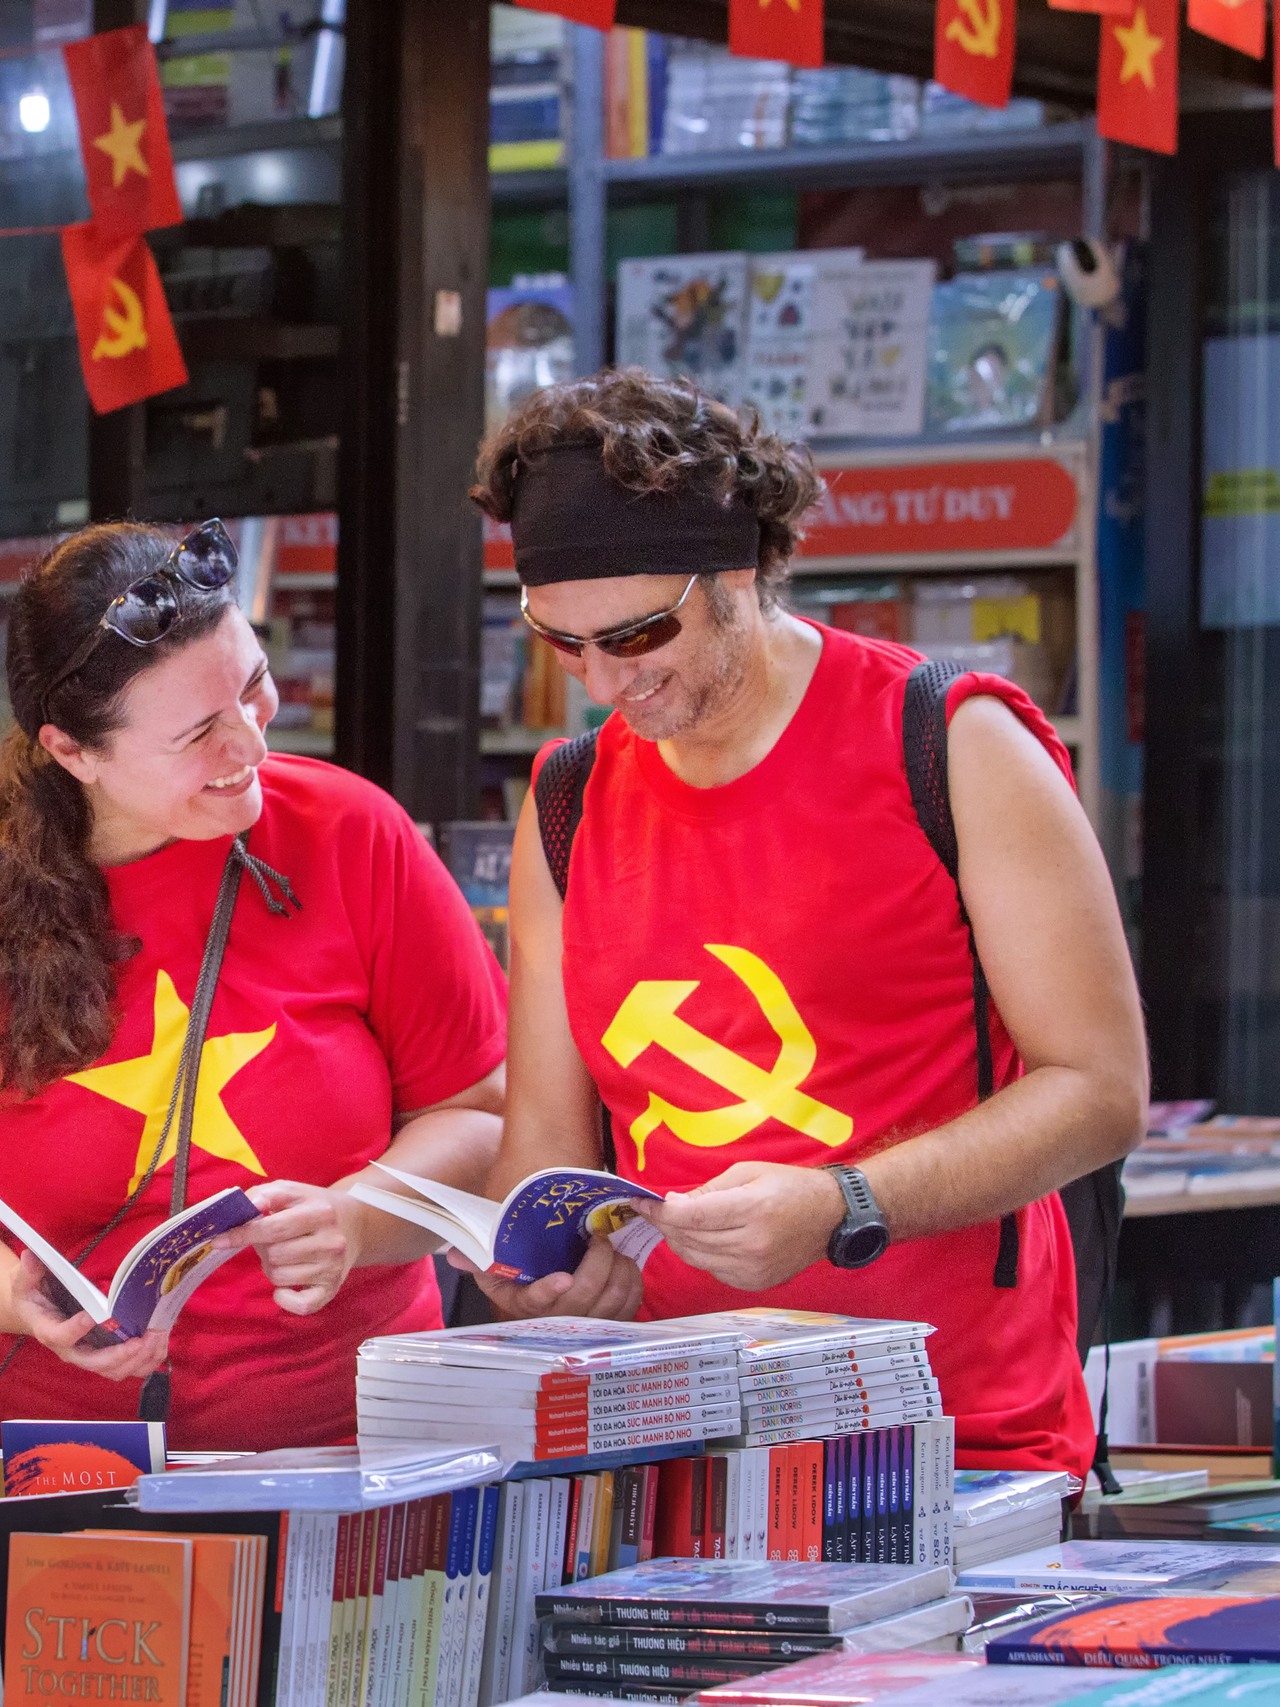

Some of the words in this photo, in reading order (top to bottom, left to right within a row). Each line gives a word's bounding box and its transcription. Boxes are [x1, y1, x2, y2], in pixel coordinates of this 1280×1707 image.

[943, 486, 1016, 522] DUY
[750, 1363, 768, 1373] DANA
[769, 1360, 790, 1369] NORRIS
[754, 1377, 771, 1386] DANA
[772, 1374, 793, 1383] NORRIS
[758, 1391, 775, 1401] DANA
[776, 1388, 798, 1398] NORRIS
[762, 1404, 779, 1414] DANA
[780, 1402, 802, 1411] NORRIS
[762, 1418, 779, 1428] DANA
[781, 1415, 803, 1424] NORRIS
[760, 1432, 777, 1442] DANA
[779, 1429, 801, 1439] NORRIS
[36, 1476, 57, 1486] THE
[63, 1471, 116, 1486] MOST
[22, 1606, 164, 1667] STICK
[571, 1633, 592, 1646] Nhiều
[594, 1635, 607, 1646] tác
[608, 1634, 620, 1648] giả
[633, 1636, 665, 1650] THƯƠNG
[667, 1638, 686, 1652] HIỆU
[1008, 1650, 1065, 1664] ADYASHANTI
[1084, 1646, 1112, 1665] ĐIỀU
[1114, 1653, 1148, 1666] QUAN
[21, 1665, 163, 1703] TOGETHER
